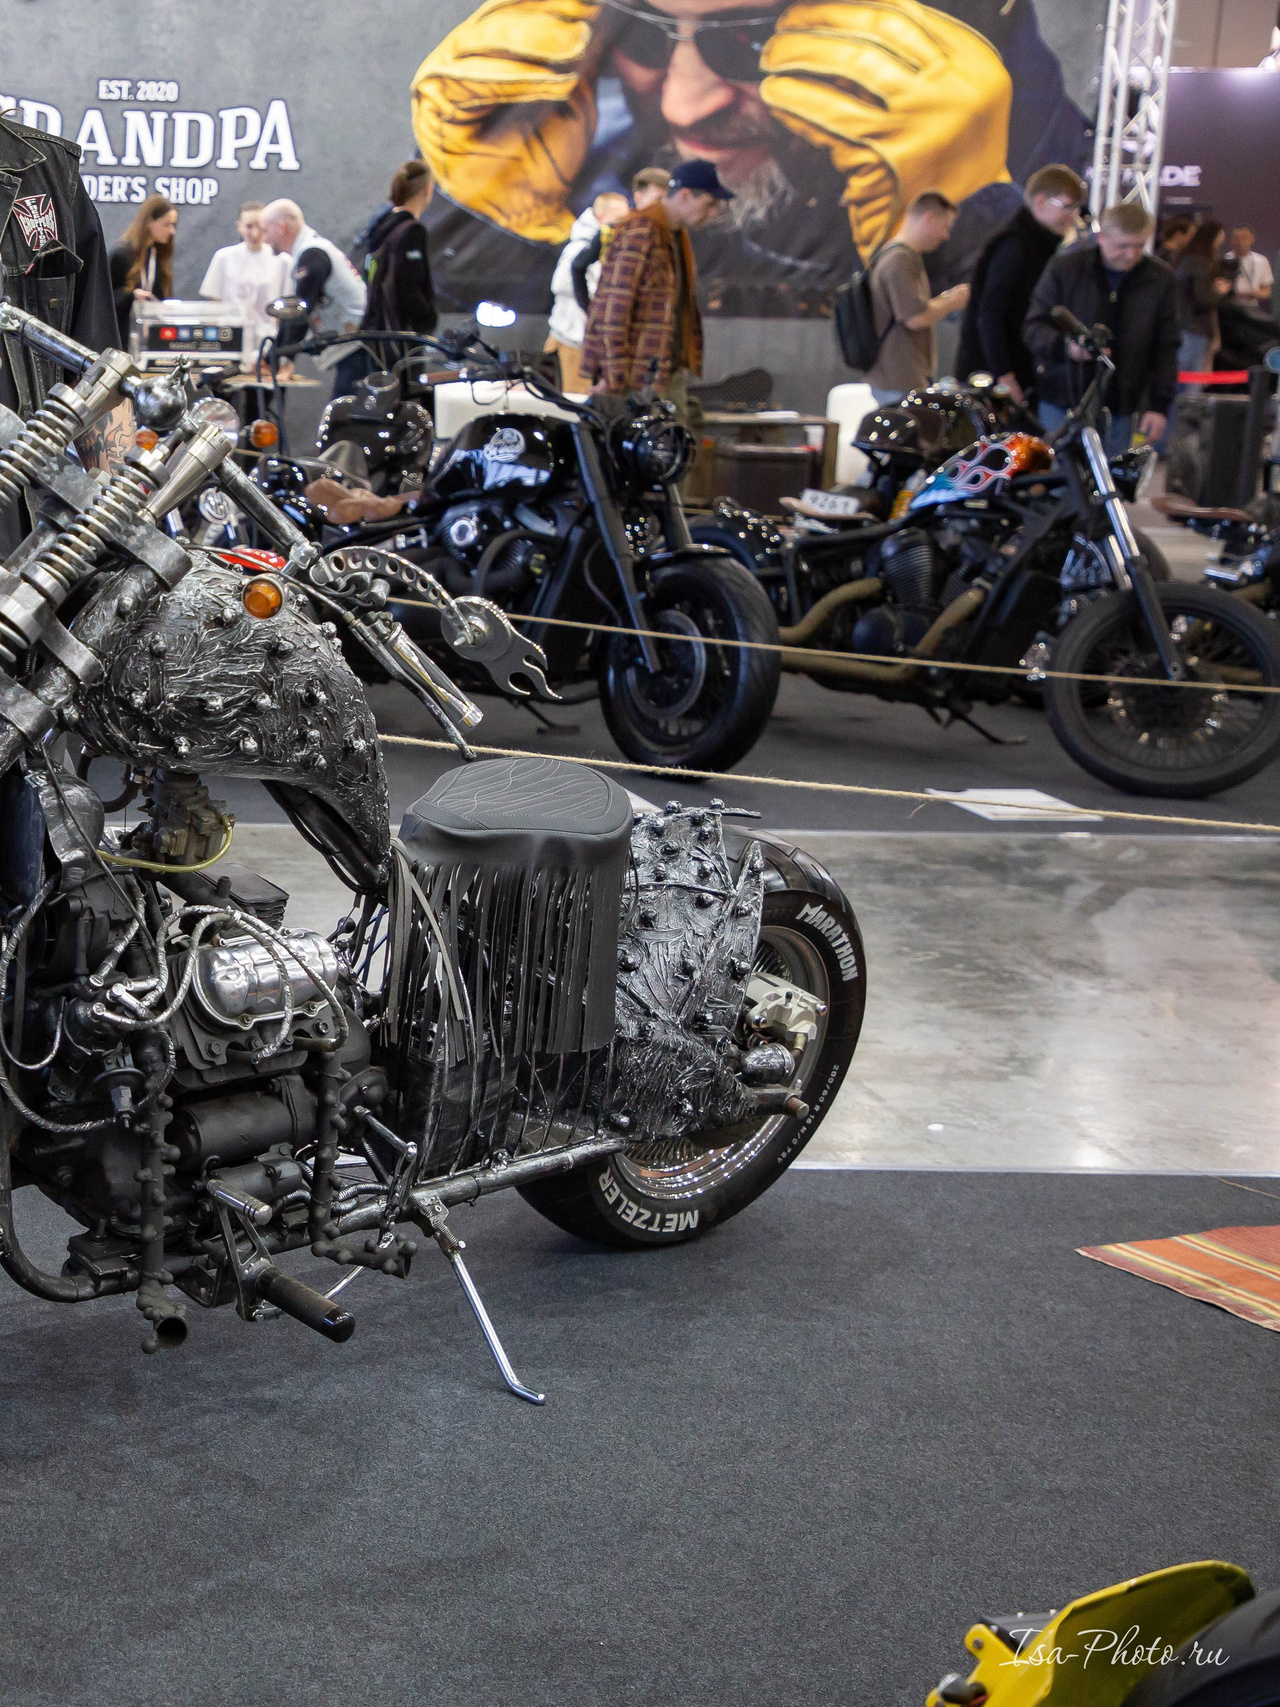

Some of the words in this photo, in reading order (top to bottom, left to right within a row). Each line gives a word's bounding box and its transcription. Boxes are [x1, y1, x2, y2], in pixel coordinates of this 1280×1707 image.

[98, 79, 134, 101] EST.
[136, 81, 179, 102] 2020
[154, 176, 219, 205] SHOP
[795, 902, 859, 982] MARATHON
[598, 1165, 700, 1233] METZELER
